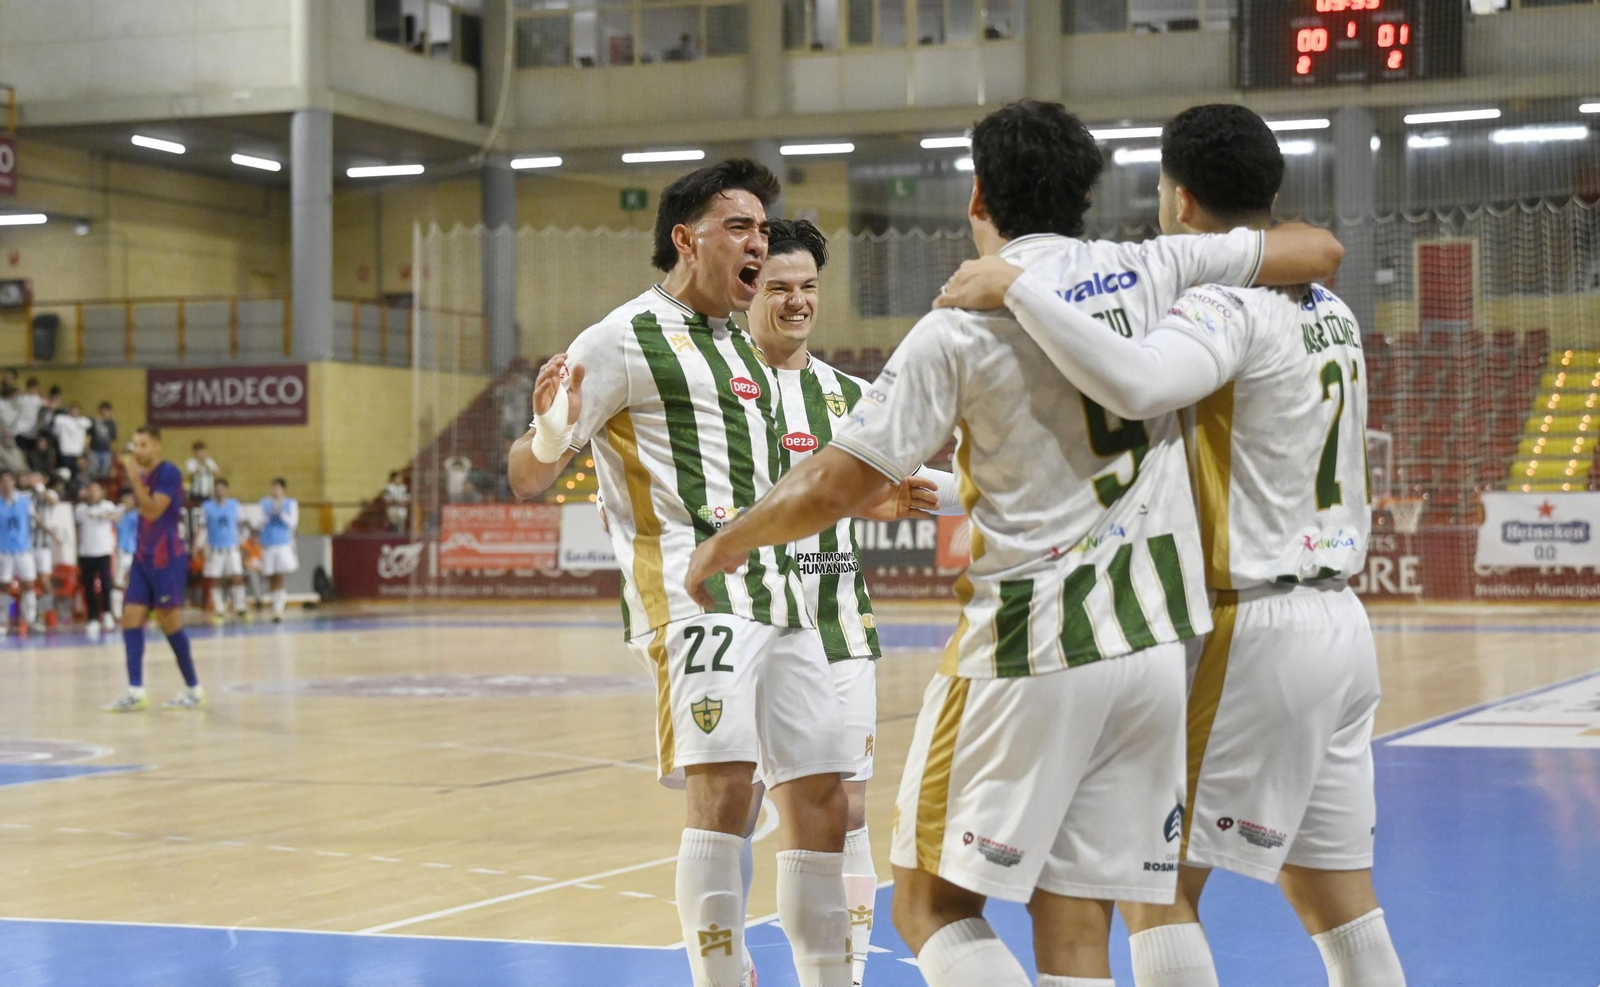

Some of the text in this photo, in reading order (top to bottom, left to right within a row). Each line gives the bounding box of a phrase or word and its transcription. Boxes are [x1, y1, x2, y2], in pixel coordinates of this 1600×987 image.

[1297, 28, 1328, 52] 00
[1377, 23, 1409, 47] 01
[185, 375, 304, 407] IMDECO
[1506, 524, 1586, 539] Heineken
[797, 561, 859, 575] HUMANIDAD
[1475, 582, 1600, 599] Instituto Municipal
[683, 625, 735, 675] 22
